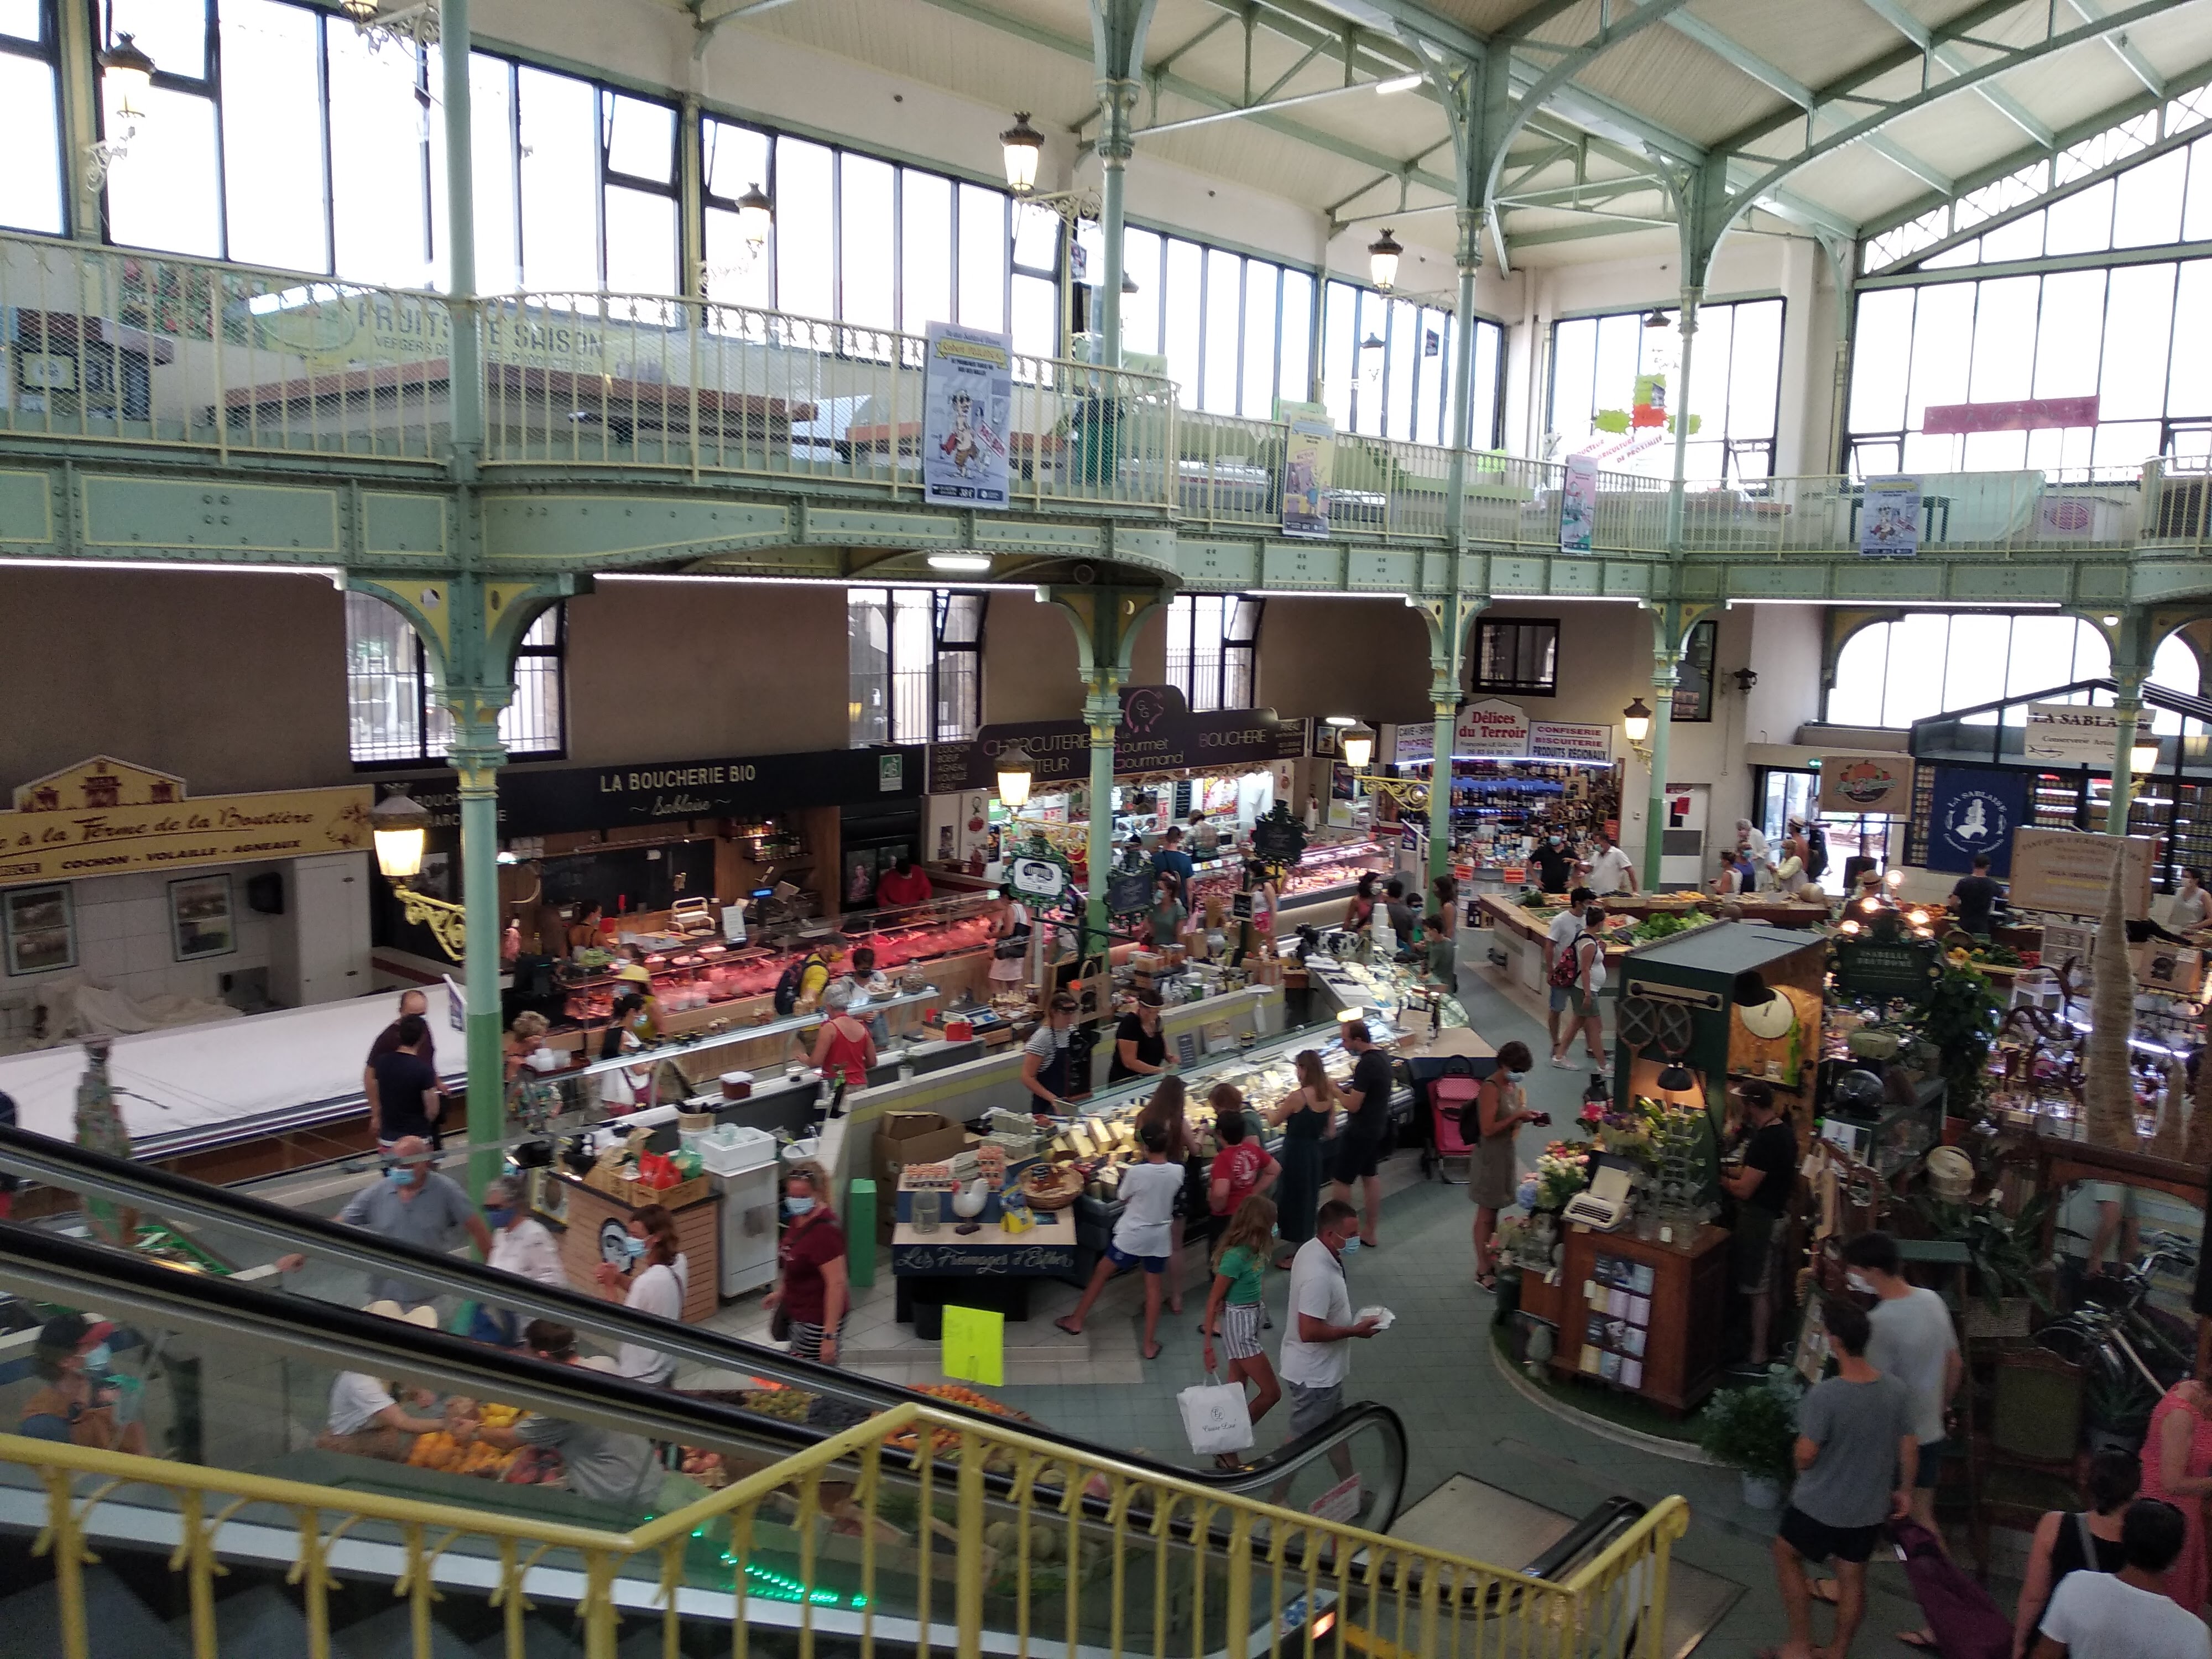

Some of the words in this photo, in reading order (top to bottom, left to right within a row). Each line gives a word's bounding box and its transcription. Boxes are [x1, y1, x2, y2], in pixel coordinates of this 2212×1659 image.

[1472, 709, 1516, 724] Délices
[2032, 712, 2055, 724] LA
[1459, 726, 1475, 738] du
[1481, 726, 1527, 739] Terroir
[1537, 726, 1603, 736] CONFISERIE
[1535, 737, 1603, 747] BISCUITERIE
[600, 774, 623, 793] LA
[628, 766, 725, 791] BOUCHERIE
[729, 764, 756, 782] BIO
[41, 827, 67, 843] la
[71, 816, 148, 841] Ferme
[154, 816, 181, 831] de
[187, 813, 211, 830] la
[61, 855, 131, 870] COCHON
[145, 847, 217, 862] VOLAILLE
[232, 839, 302, 854] AGNEAUX
[894, 1246, 935, 1269] Les
